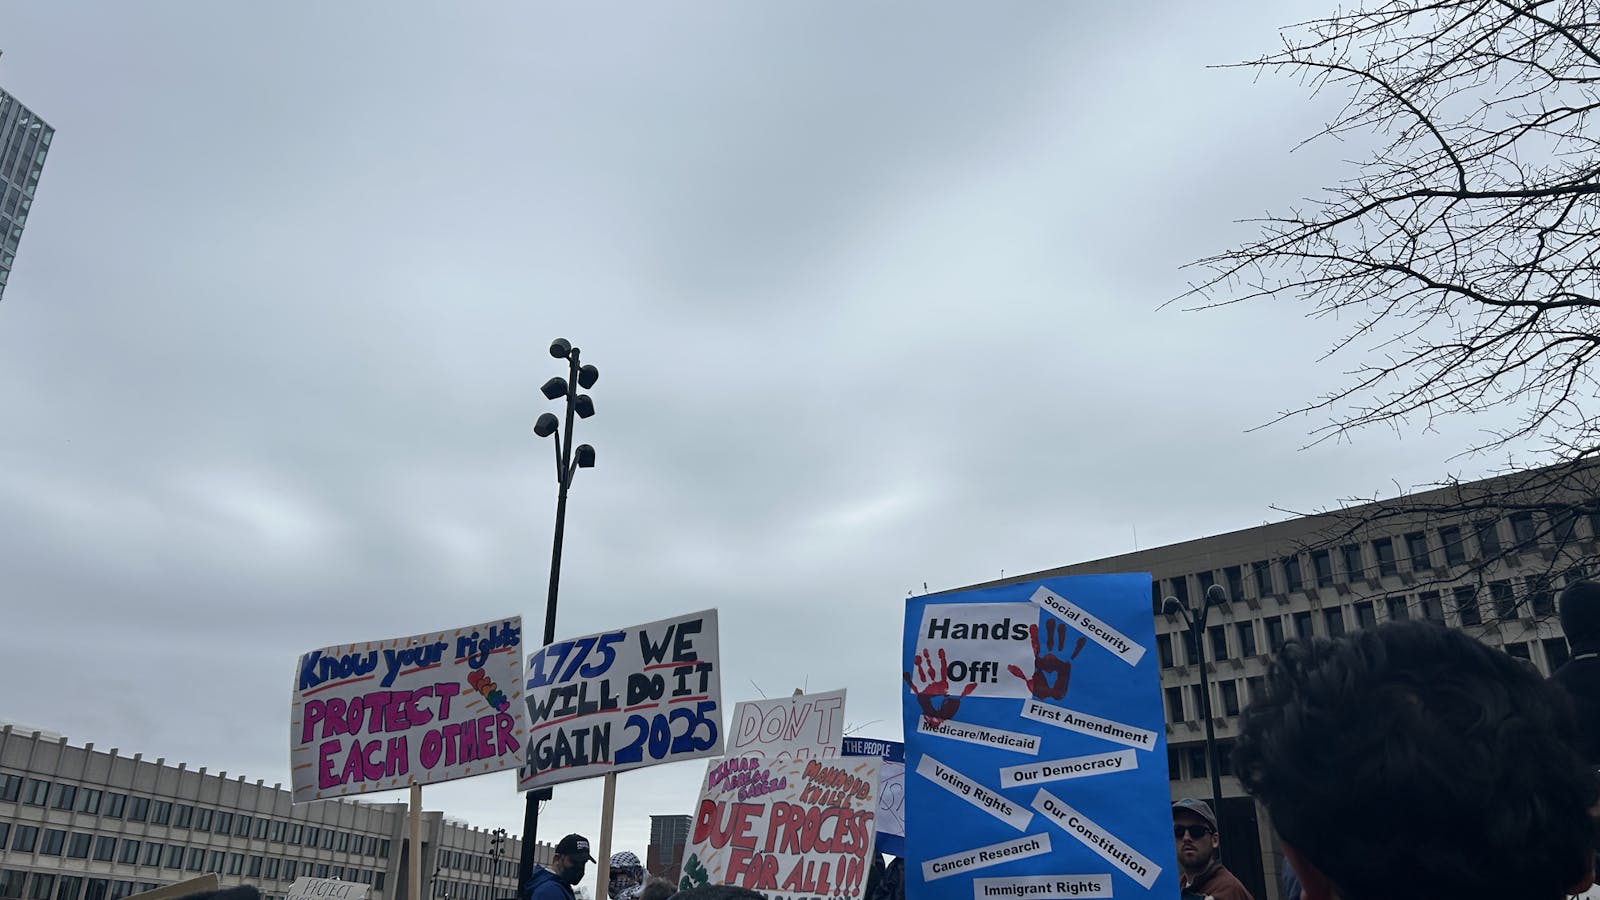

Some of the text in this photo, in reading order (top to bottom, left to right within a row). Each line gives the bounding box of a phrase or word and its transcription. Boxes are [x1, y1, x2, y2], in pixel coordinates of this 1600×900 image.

[927, 617, 1029, 641] Hands
[1044, 595, 1131, 654] Social Security
[299, 621, 521, 691] Know your rights
[526, 619, 703, 690] 1775 WE
[947, 660, 999, 683] Off!
[301, 682, 461, 744] PROTECT
[525, 679, 619, 725] WILL
[672, 662, 713, 697] IT
[520, 701, 718, 778] AGAIN 2025
[844, 740, 863, 754] THE
[863, 742, 891, 757] PEOPLE
[922, 721, 1036, 750] Medicare/Medicaid
[1030, 703, 1150, 745] First Amendment
[319, 711, 521, 790] EACH OTHER
[1013, 755, 1123, 782] Our Democracy
[934, 765, 971, 798] Voting
[973, 783, 1013, 816] Rights
[692, 799, 874, 857] DUE PROCESS
[1043, 799, 1148, 877] Our Constitution
[724, 848, 779, 891] FOR
[932, 839, 1040, 874] Cancer Research
[984, 881, 1102, 899] Immigrant Rights
